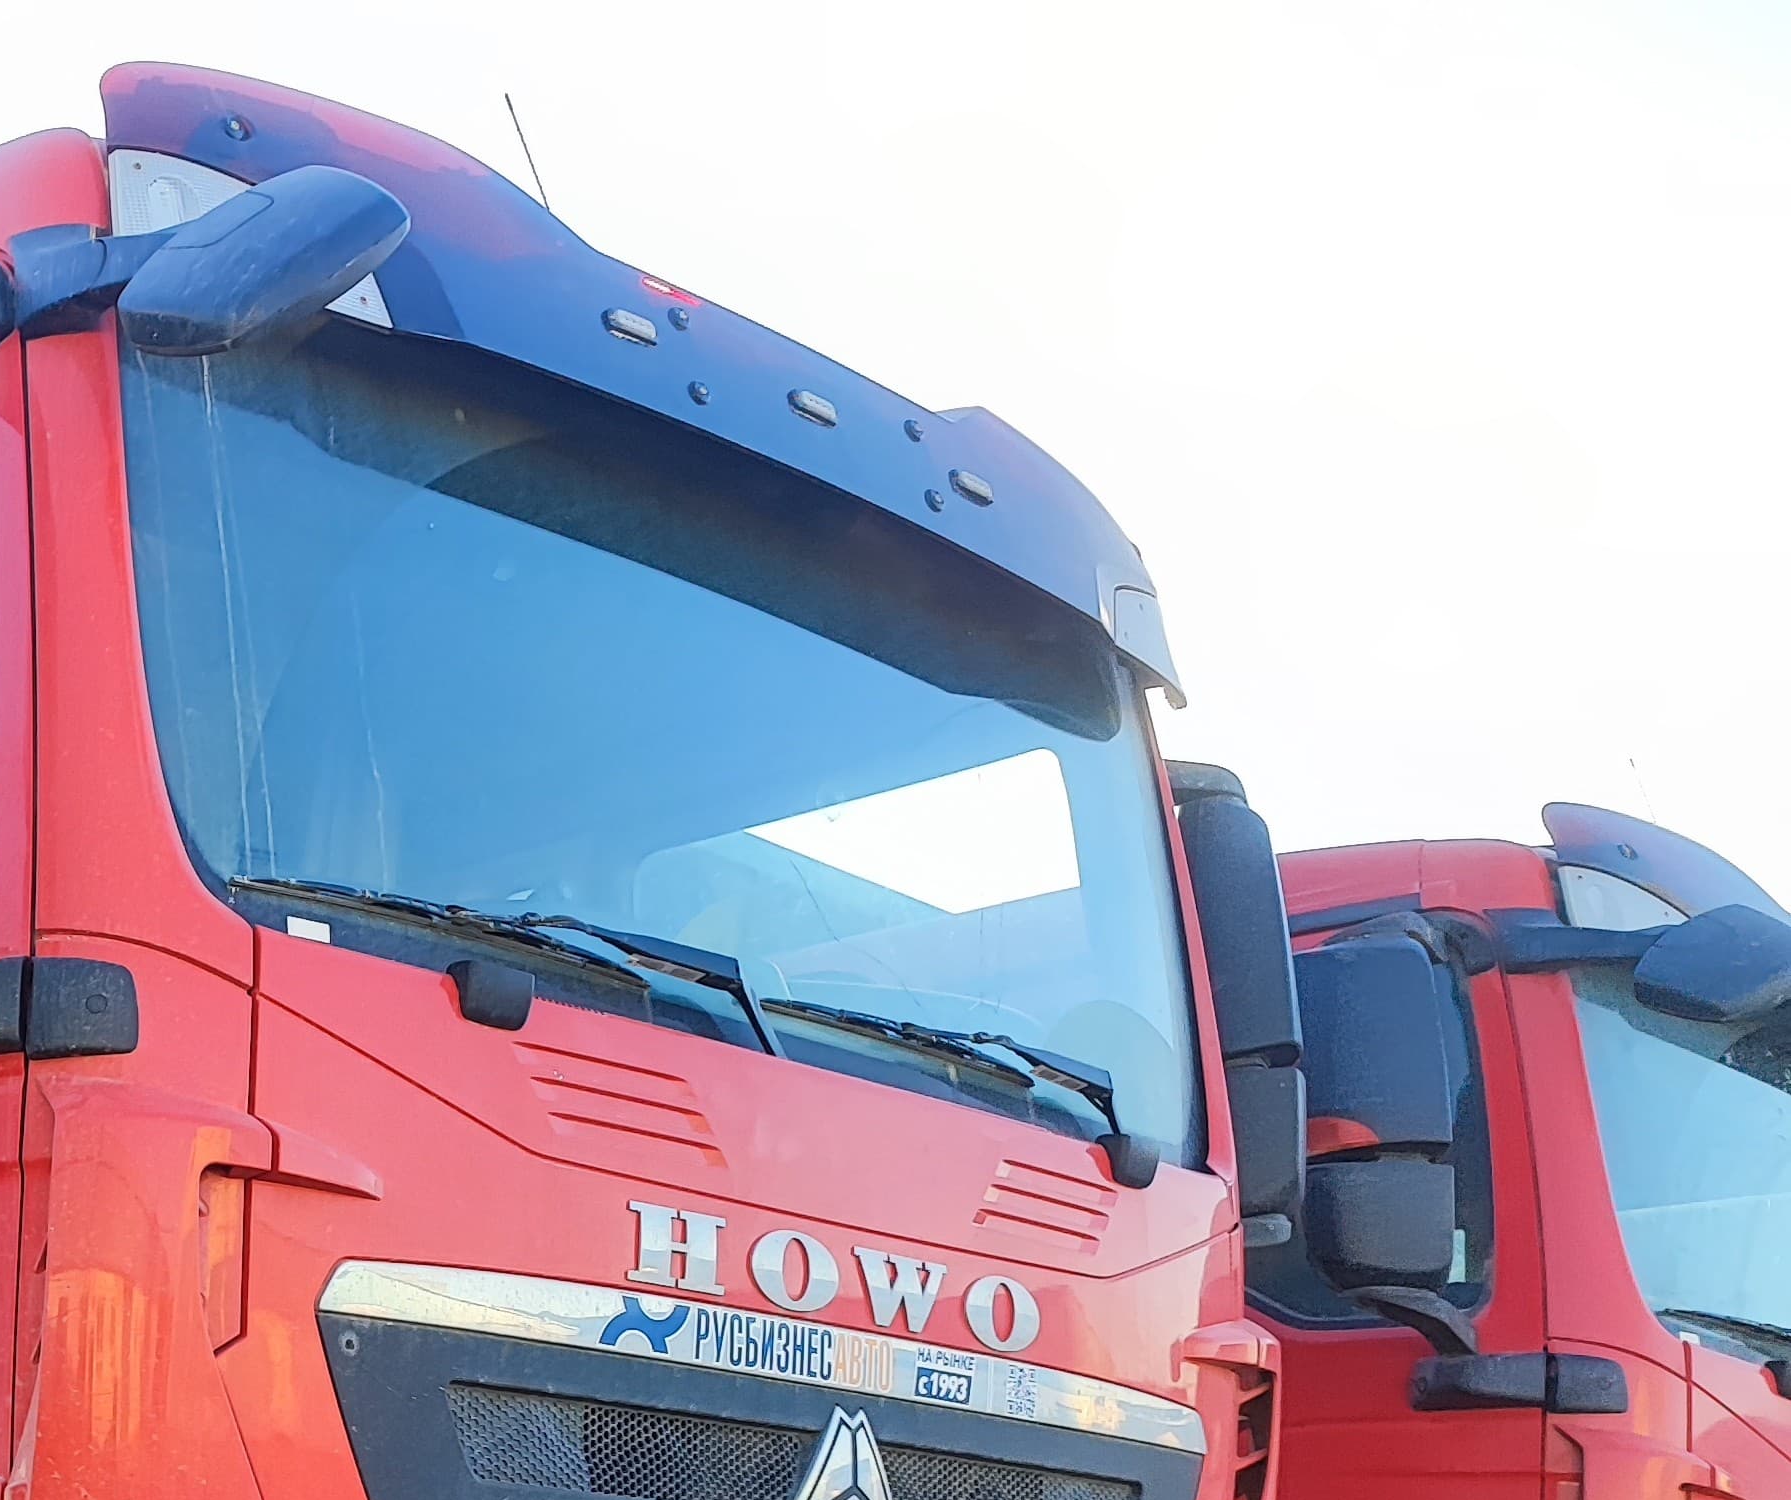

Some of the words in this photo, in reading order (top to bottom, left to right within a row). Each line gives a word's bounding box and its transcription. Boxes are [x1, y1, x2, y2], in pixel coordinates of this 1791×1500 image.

[625, 1201, 1041, 1353] HOWO
[695, 1307, 893, 1392] РУСБИЗНЕСАВТО
[917, 1348, 932, 1363] НА
[936, 1351, 975, 1371] РЫНКЕ
